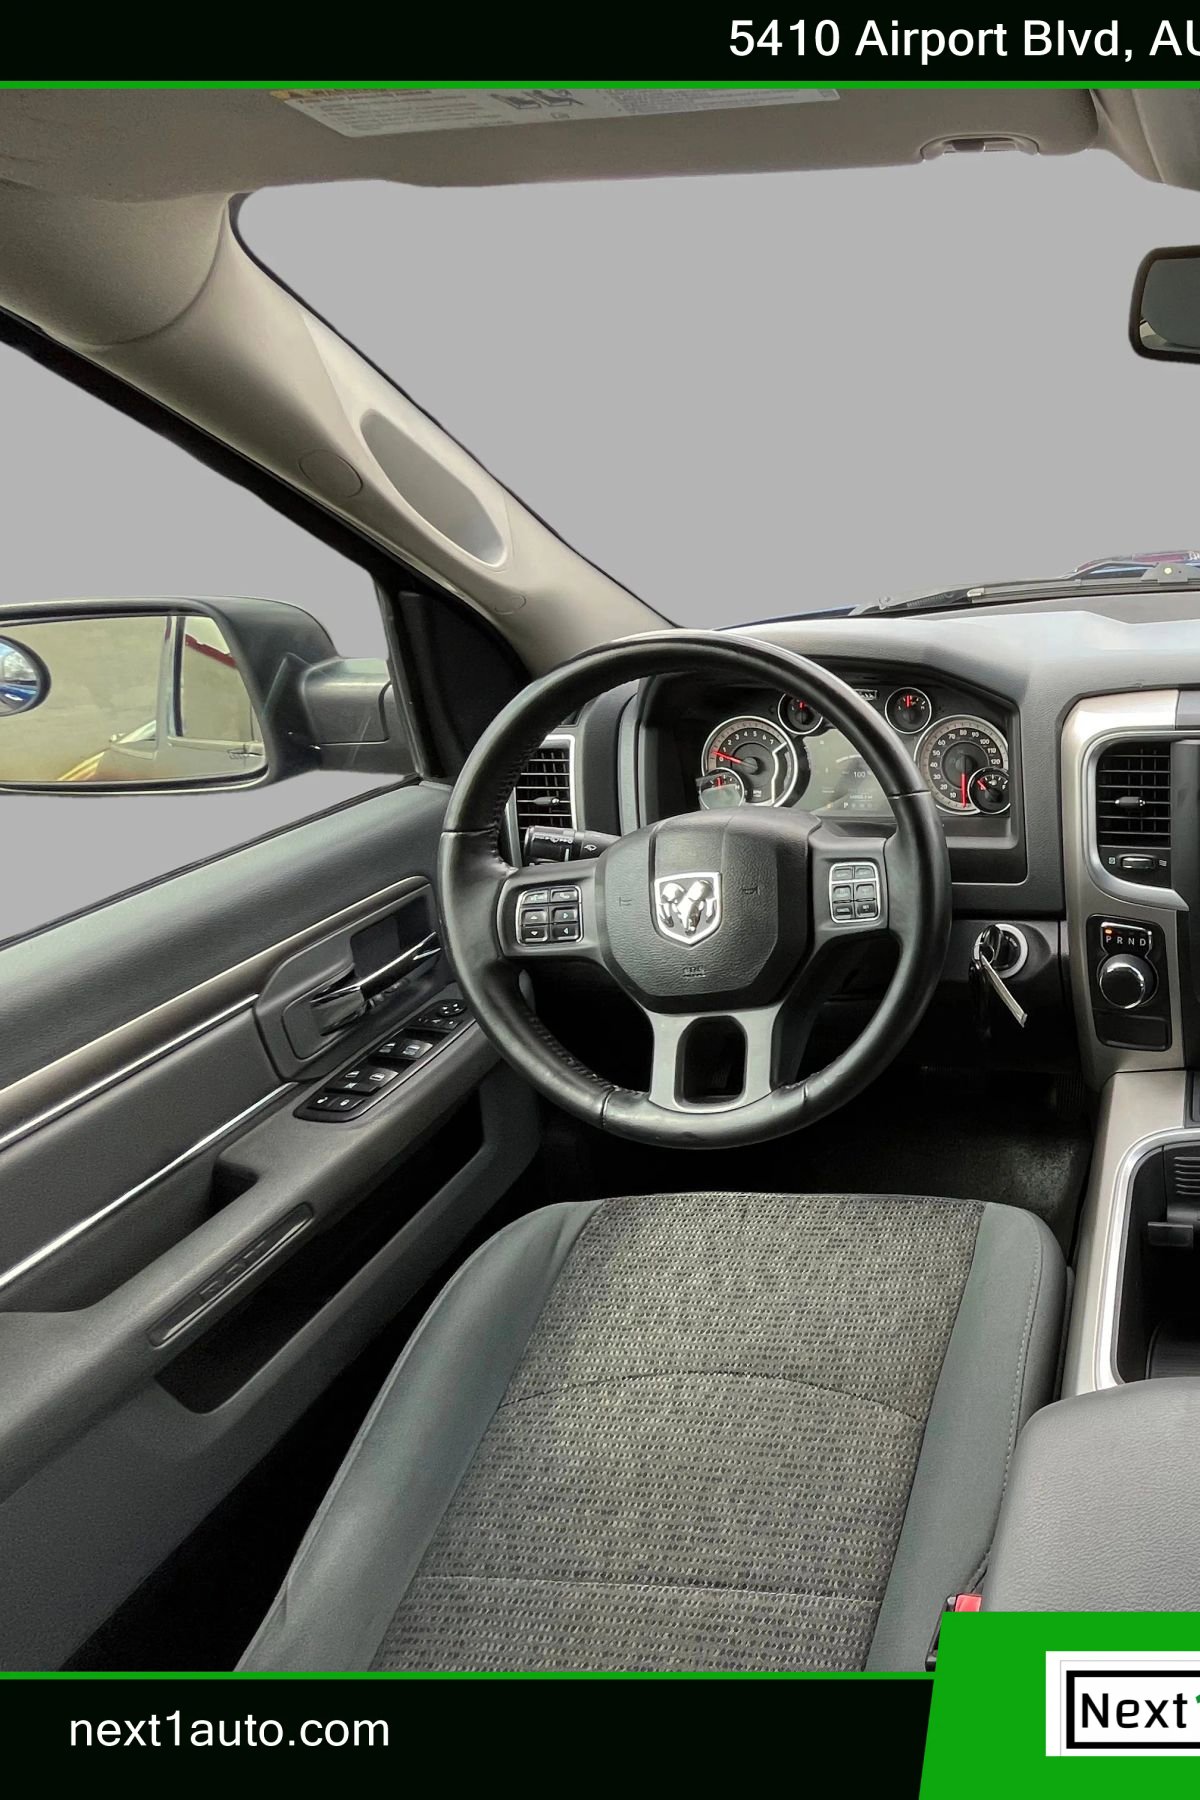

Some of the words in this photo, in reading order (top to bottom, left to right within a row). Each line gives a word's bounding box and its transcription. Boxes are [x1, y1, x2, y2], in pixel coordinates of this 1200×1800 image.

[1105, 935, 1112, 943] P
[1116, 936, 1123, 945] R
[1128, 937, 1135, 946] N
[1139, 938, 1147, 947] D
